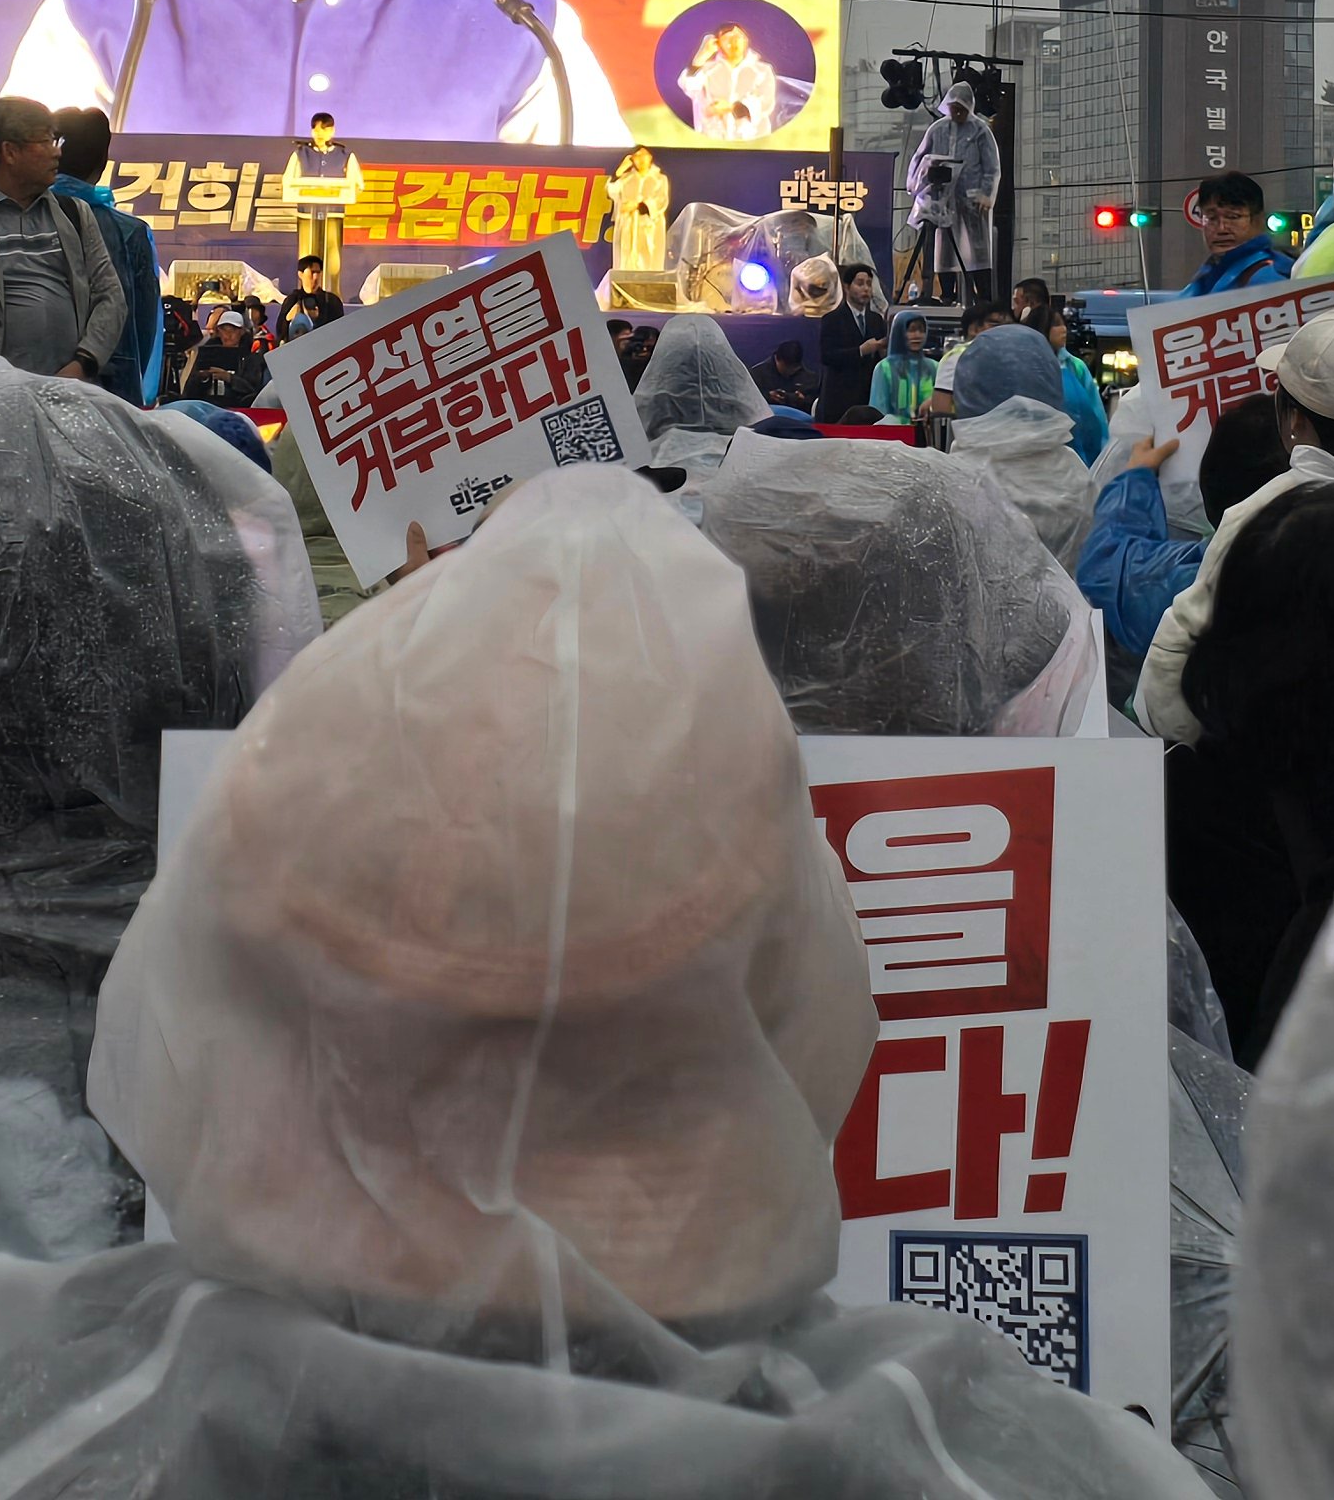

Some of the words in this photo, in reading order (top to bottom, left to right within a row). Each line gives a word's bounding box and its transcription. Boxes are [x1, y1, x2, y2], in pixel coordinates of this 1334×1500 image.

[1204, 29, 1229, 169] 안국빌딩
[97, 160, 299, 233] 건희를
[779, 180, 869, 212] 민주당
[313, 269, 549, 440] 윤석열을
[335, 326, 591, 513] 거부한다!
